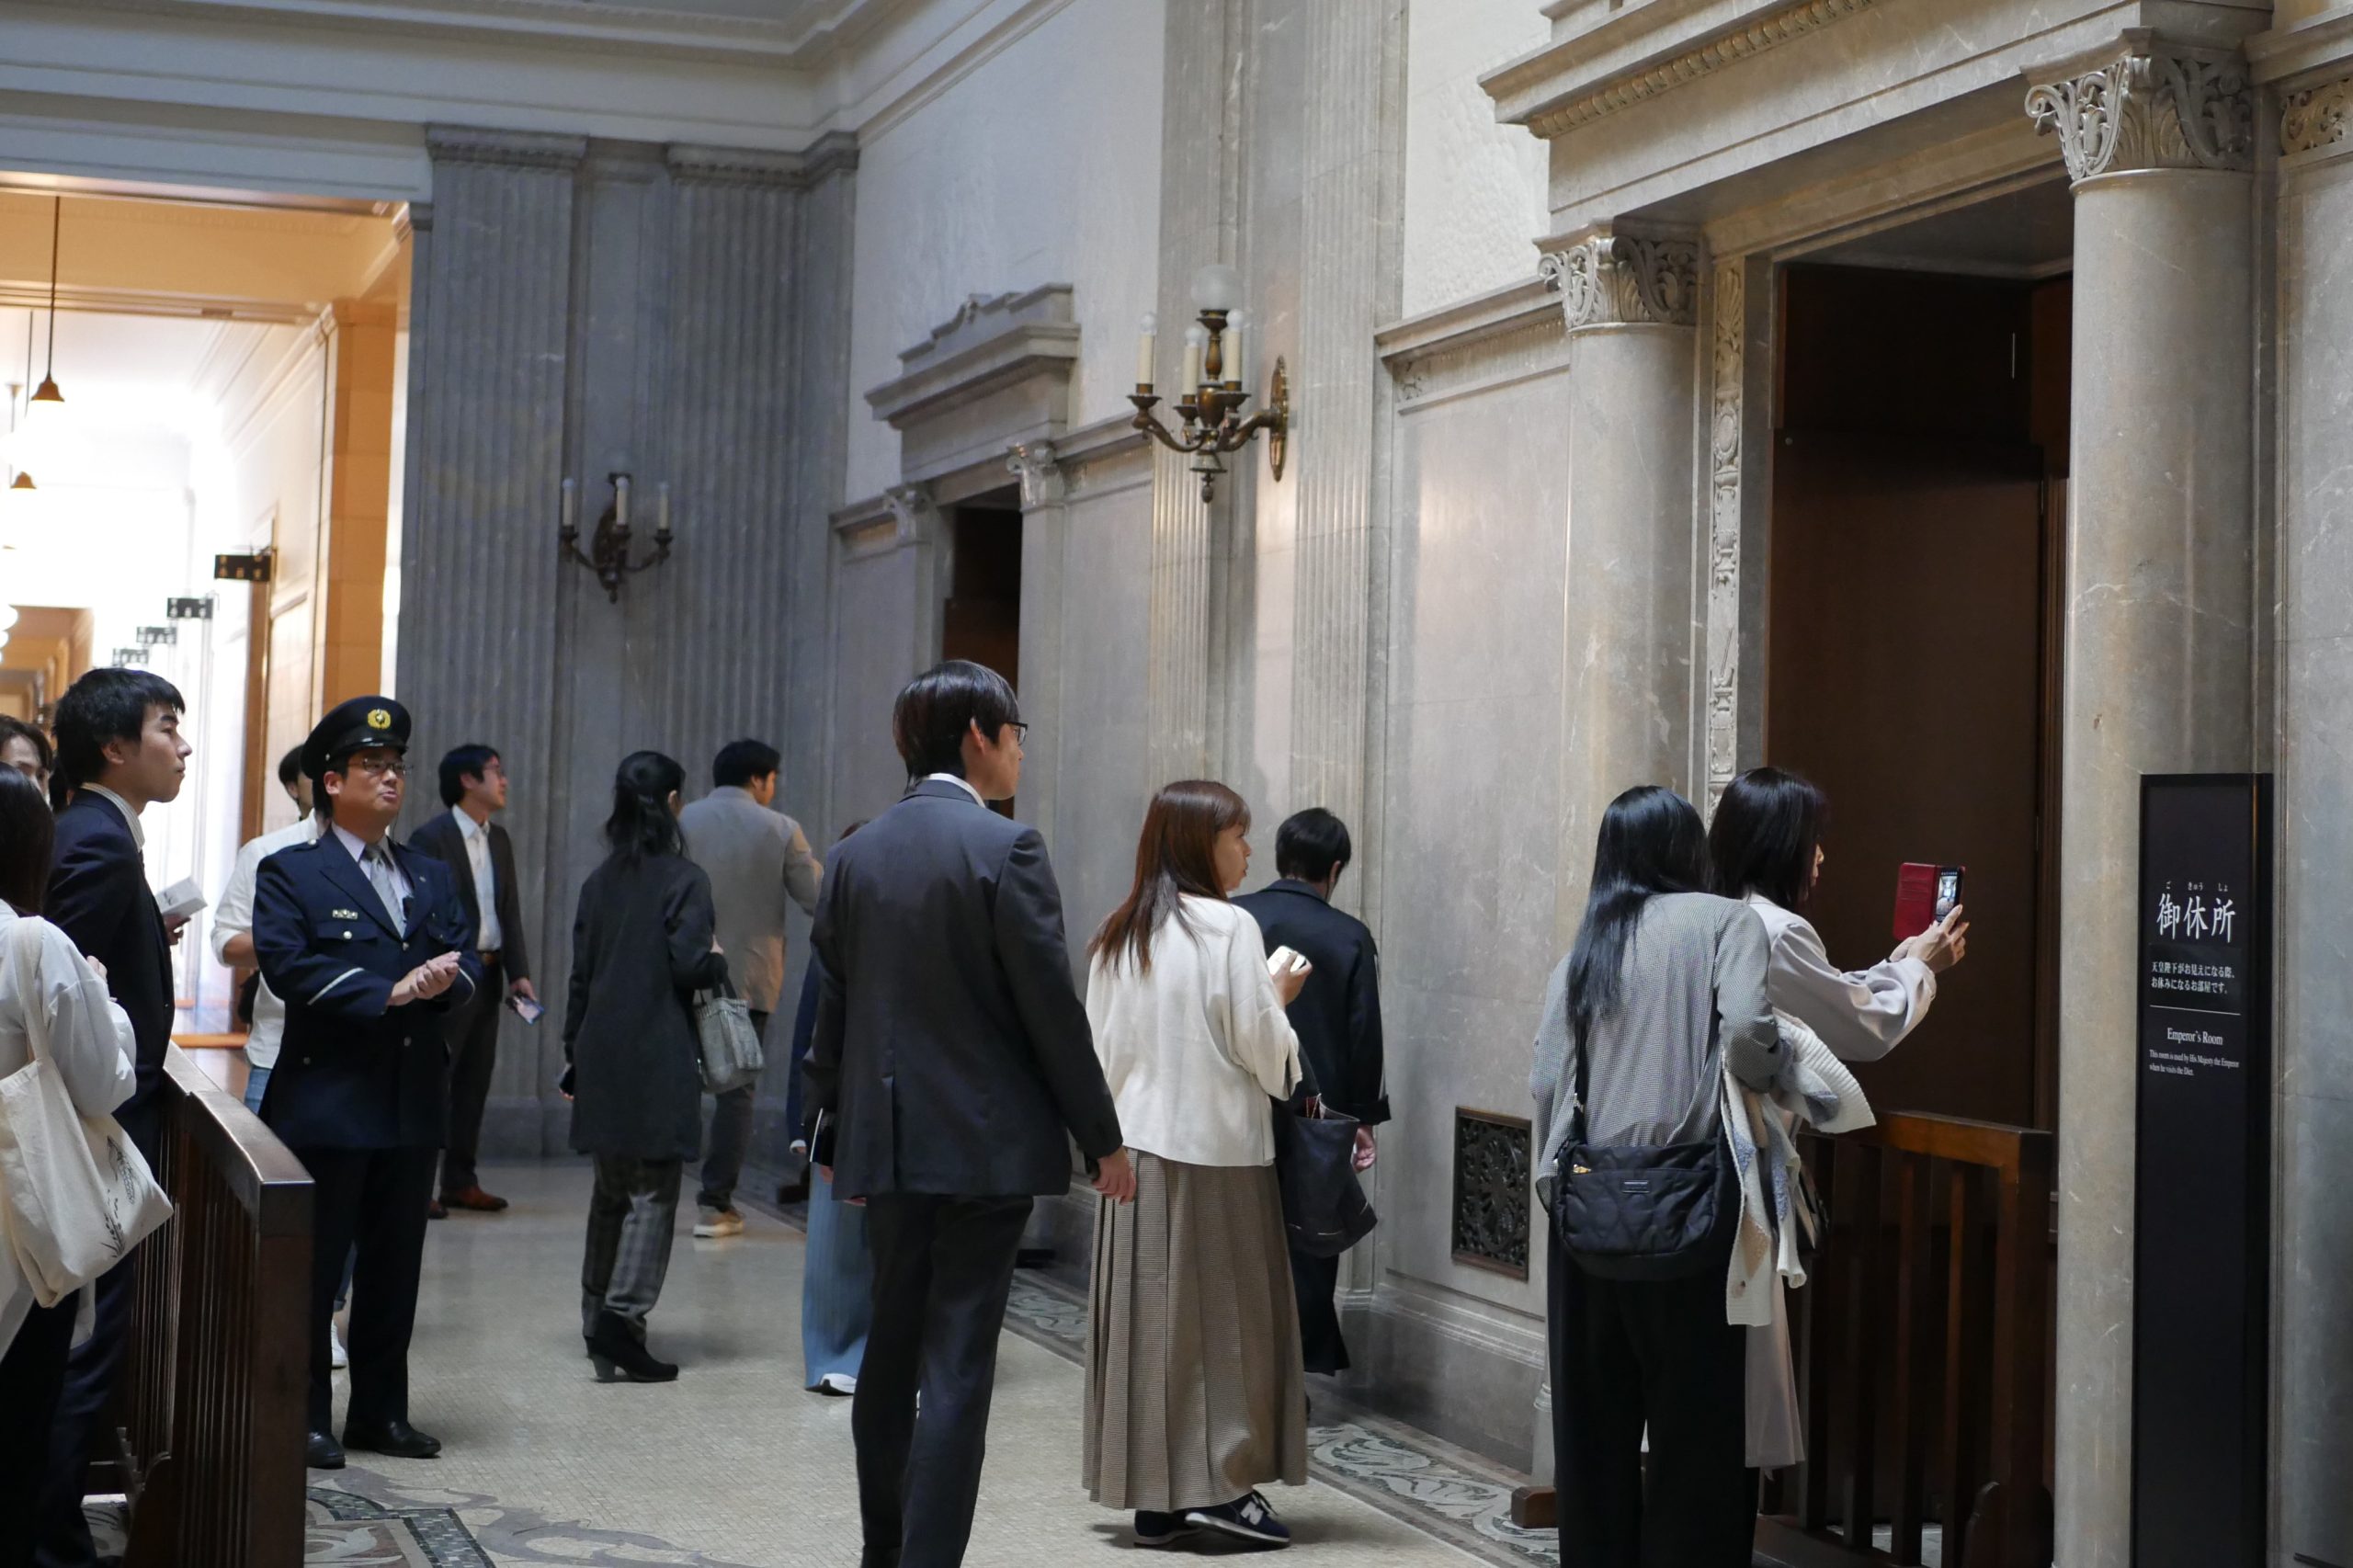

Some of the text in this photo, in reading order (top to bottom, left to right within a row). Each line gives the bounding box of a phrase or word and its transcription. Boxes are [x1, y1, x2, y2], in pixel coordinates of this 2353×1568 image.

[2156, 892, 2236, 943] 御休所
[2166, 1027, 2223, 1046] Emperor's Room
[2149, 1049, 2158, 1058] This
[2158, 1051, 2169, 1060] room
[2174, 1052, 2184, 1062] used
[2198, 1054, 2213, 1066] Majesty
[2221, 1058, 2240, 1069] Emperor
[2149, 1062, 2160, 1072] when
[1240, 1501, 1264, 1526] N
